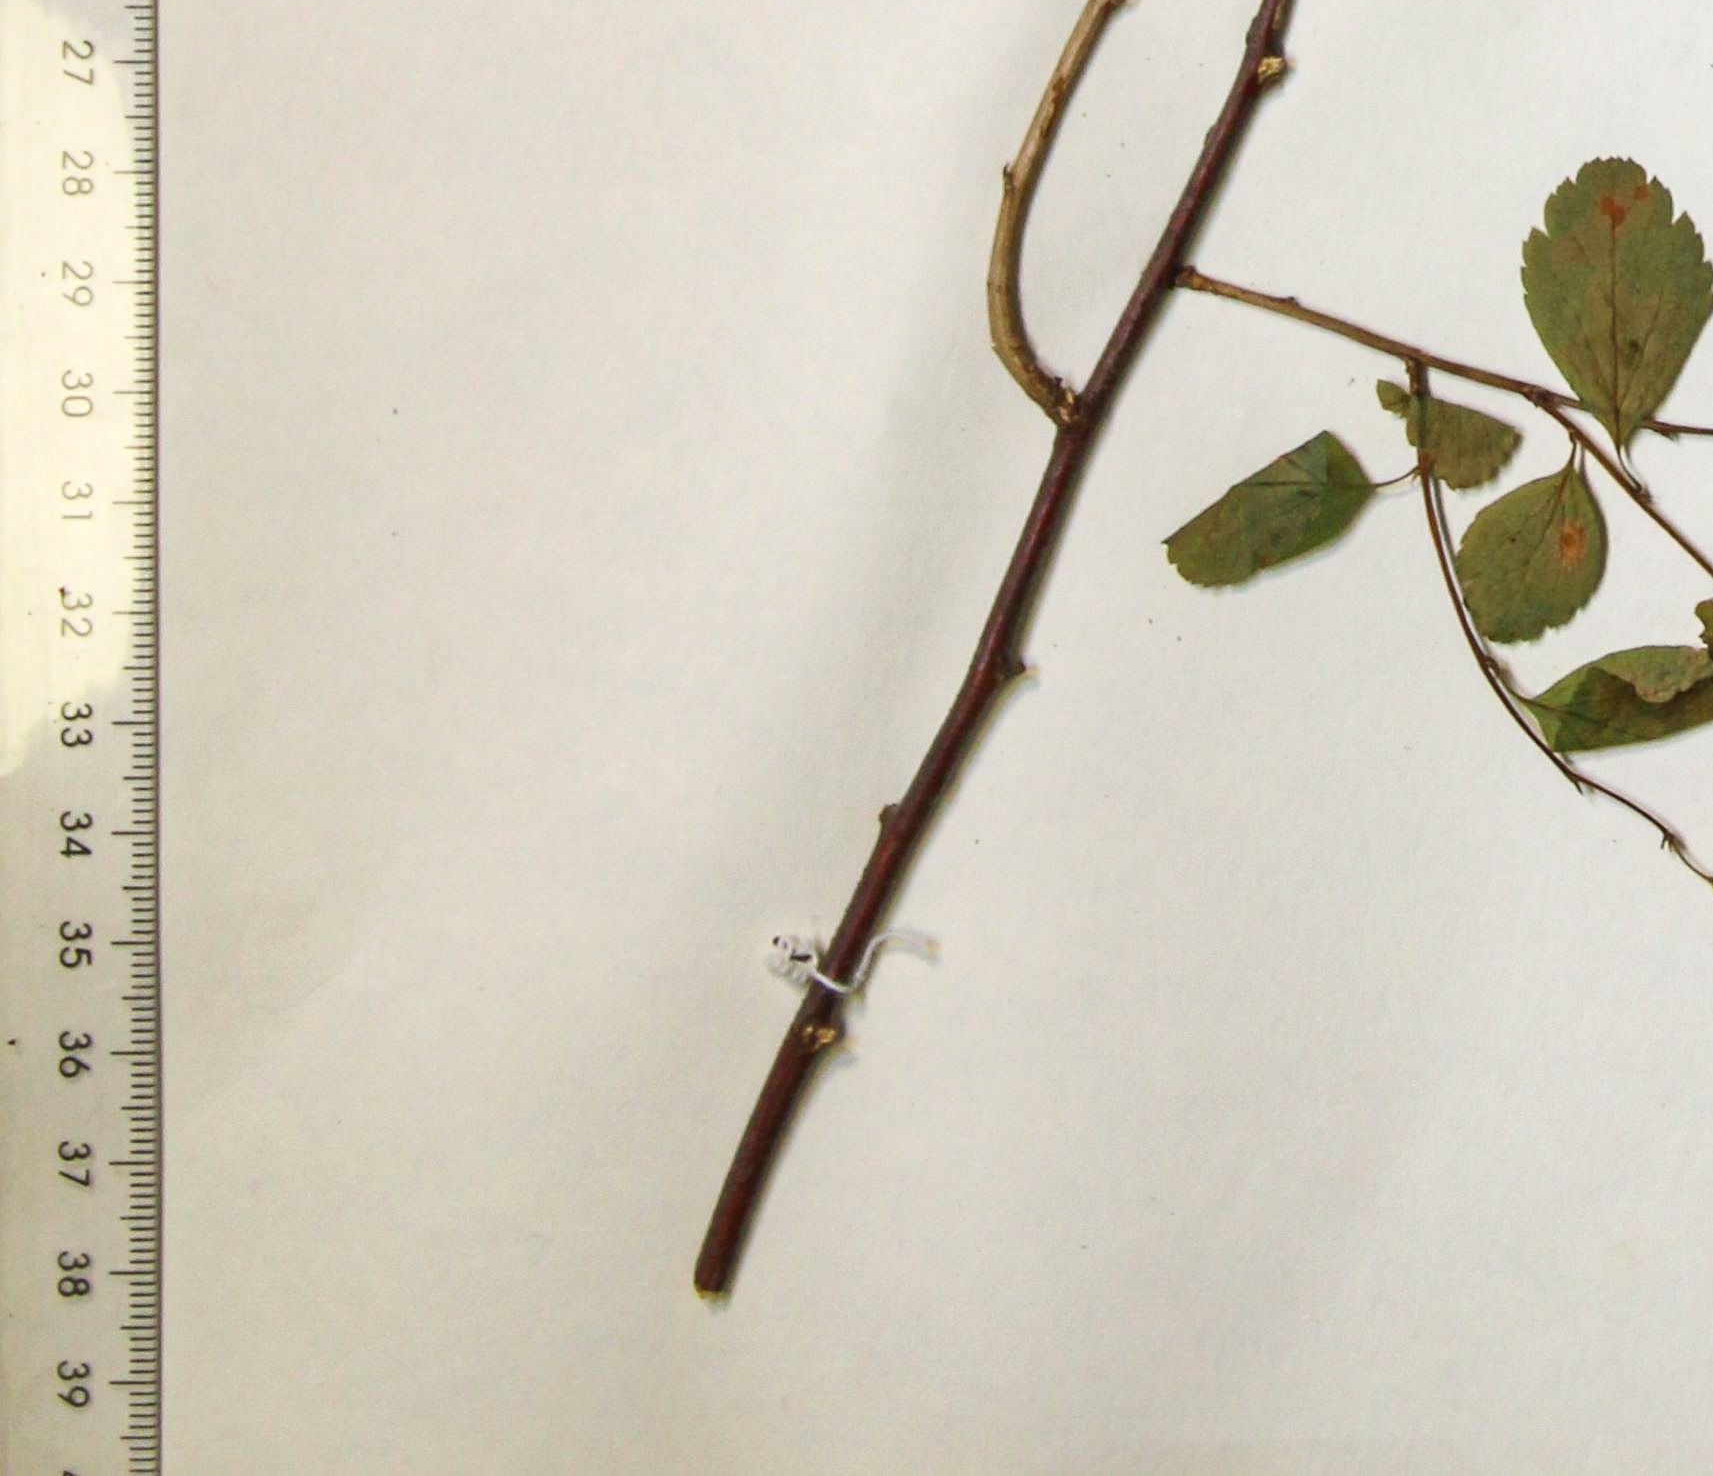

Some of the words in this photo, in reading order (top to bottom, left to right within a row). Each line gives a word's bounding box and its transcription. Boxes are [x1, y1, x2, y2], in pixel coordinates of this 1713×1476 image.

[62, 39, 95, 86] 27
[62, 150, 94, 196] 28
[62, 261, 94, 307] 29
[61, 369, 94, 418] 30
[62, 481, 93, 520] 31
[60, 592, 94, 638] 32
[59, 701, 94, 749] 33
[59, 810, 94, 859] 34
[58, 920, 94, 970] 35
[57, 1030, 94, 1080] 36
[57, 1140, 94, 1188] 37
[56, 1250, 93, 1299] 38
[56, 1360, 92, 1409] 39
